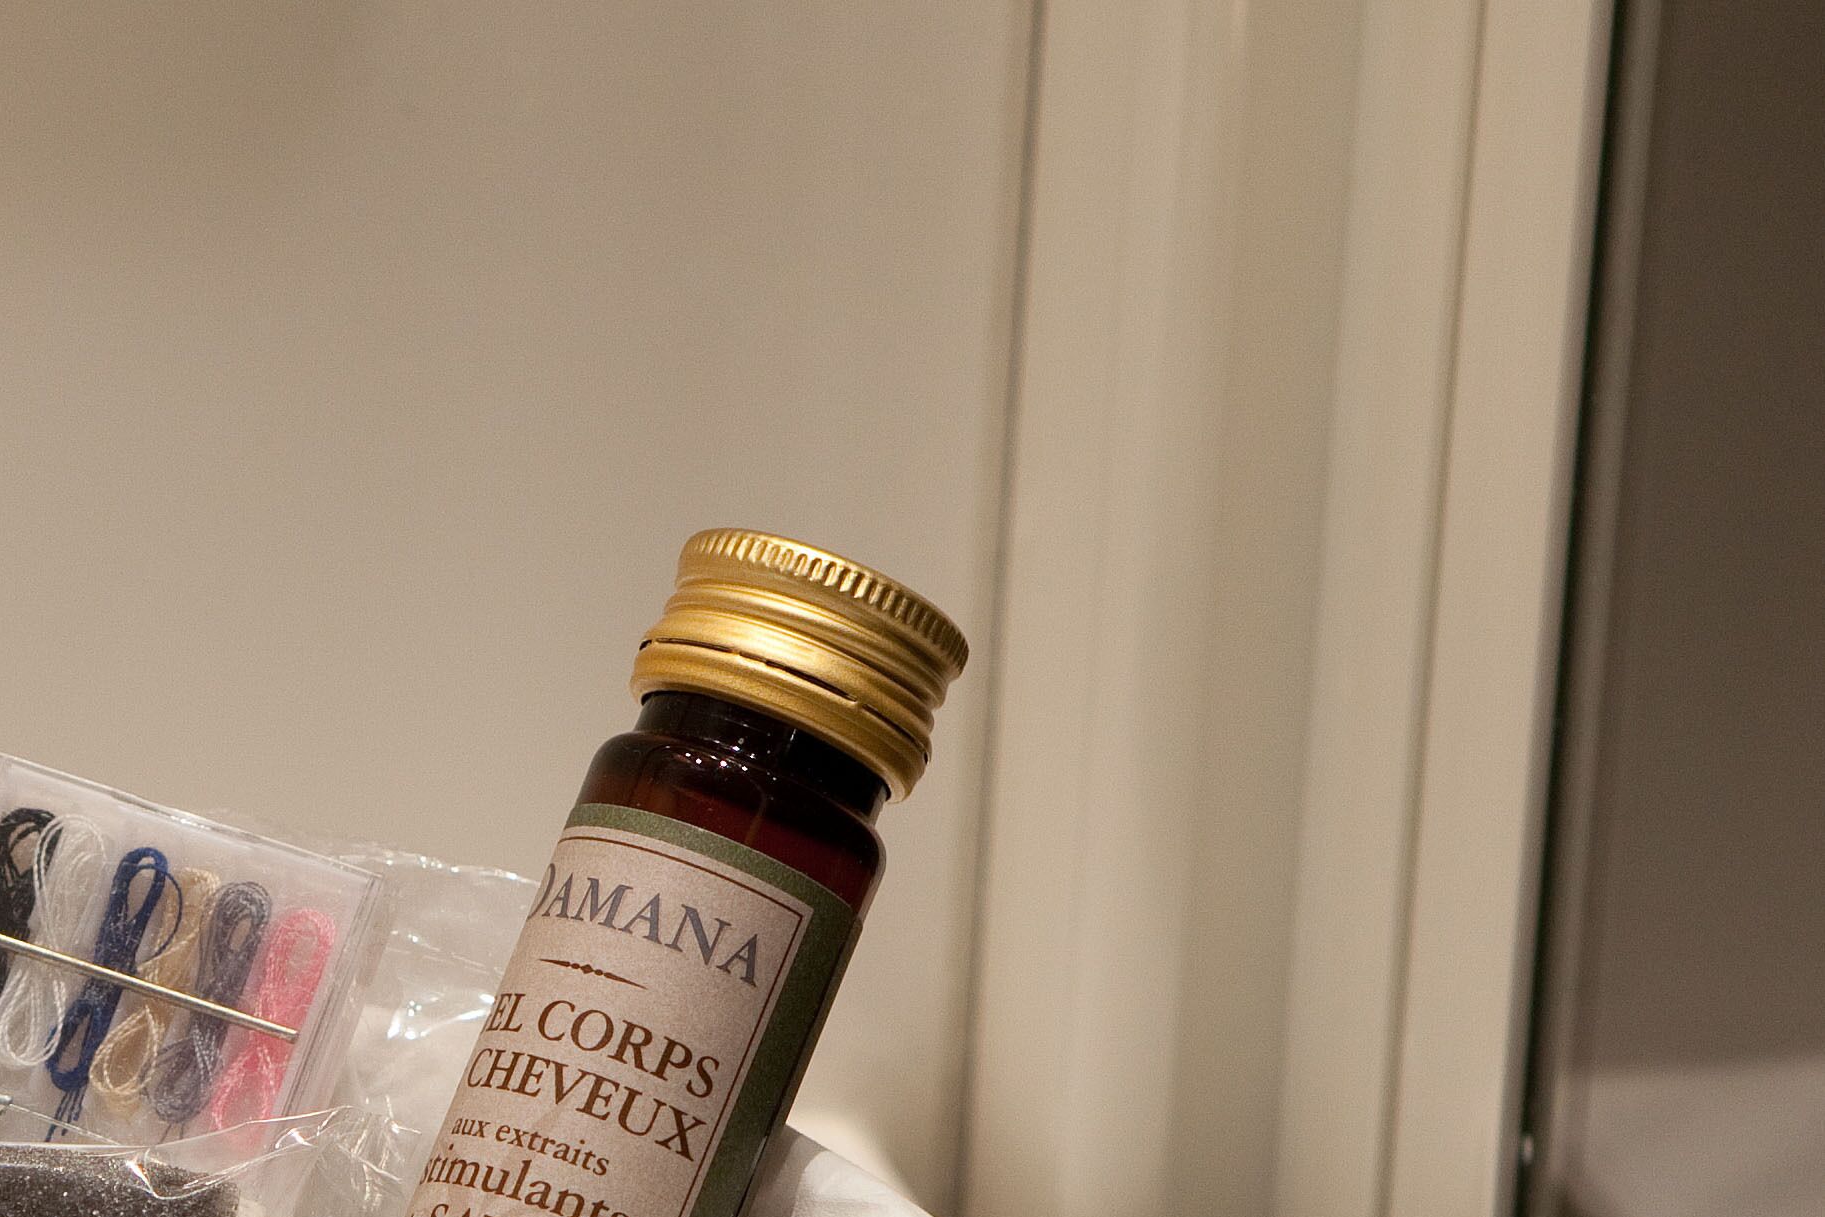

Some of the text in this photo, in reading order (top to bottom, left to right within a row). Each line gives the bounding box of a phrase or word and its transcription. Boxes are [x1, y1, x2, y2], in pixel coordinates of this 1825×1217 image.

[481, 992, 720, 1099] EL CORPS
[451, 1115, 610, 1176] aux extraits
[466, 1048, 707, 1162] CHEVEUX
